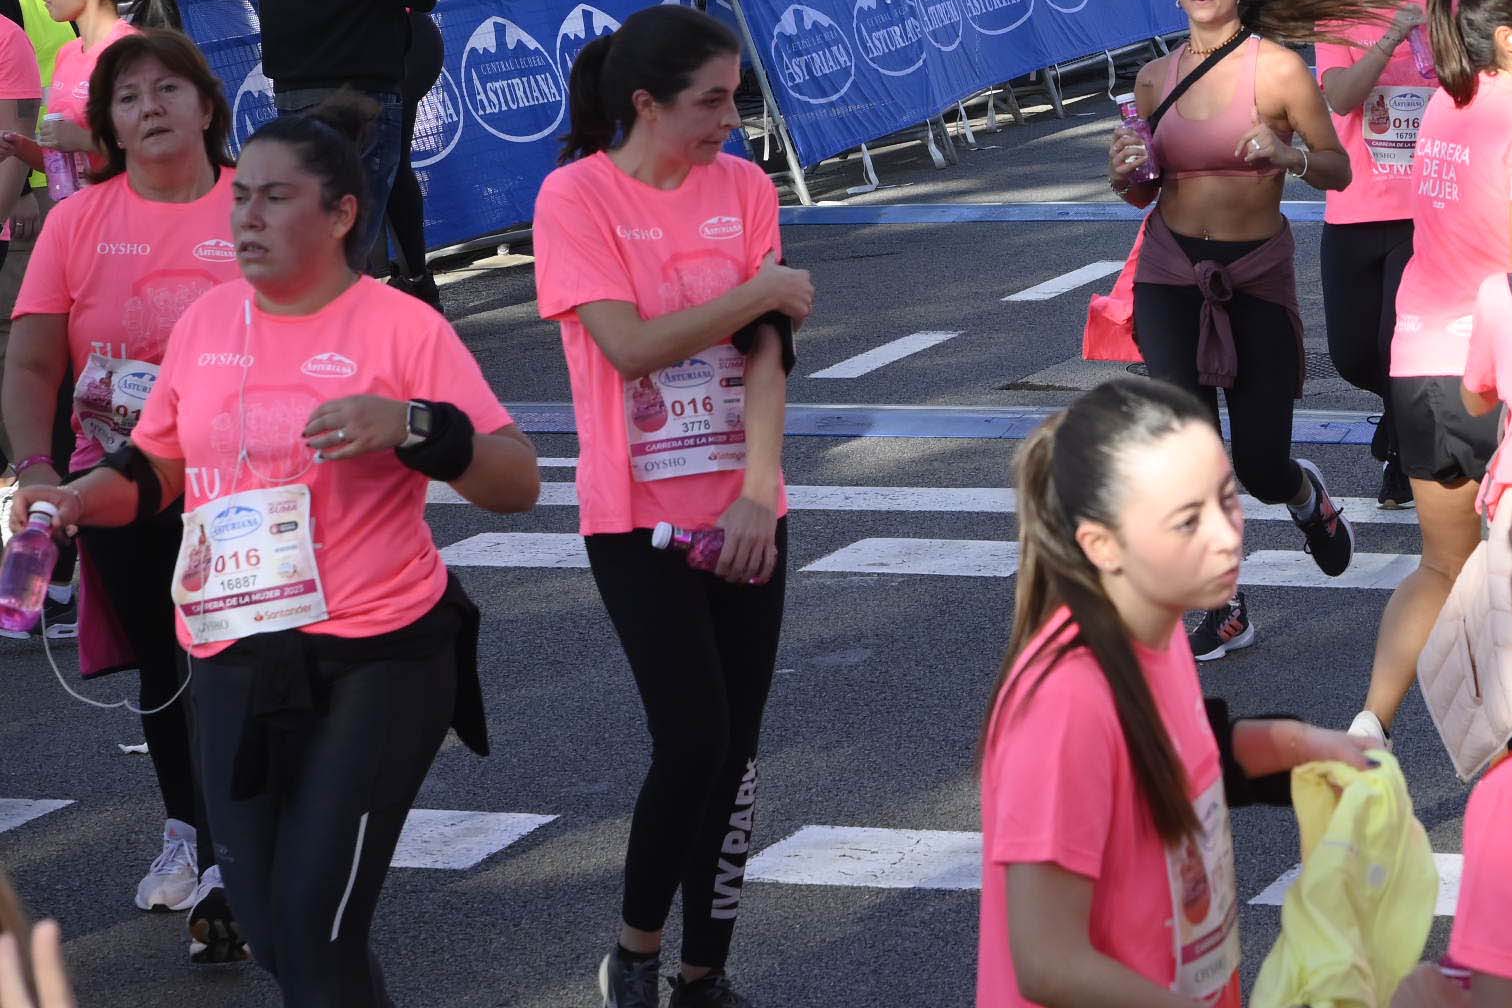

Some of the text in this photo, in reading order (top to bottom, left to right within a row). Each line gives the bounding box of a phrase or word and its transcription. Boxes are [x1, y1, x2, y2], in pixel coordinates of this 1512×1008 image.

[473, 72, 561, 115] ASTURIANA
[1393, 117, 1420, 130] 016
[1416, 139, 1471, 166] CARRERA
[1423, 159, 1439, 178] DE
[1442, 163, 1457, 180] LA
[1418, 179, 1460, 201] MUJER
[97, 242, 150, 256] OYSHO
[198, 352, 254, 367] OYSHO
[671, 395, 714, 417] 016
[681, 419, 711, 433] 3778
[644, 456, 687, 473] OYSHO
[185, 466, 222, 500] TU
[214, 548, 261, 573] 016
[220, 575, 258, 591] 16887
[264, 603, 313, 621] Santander
